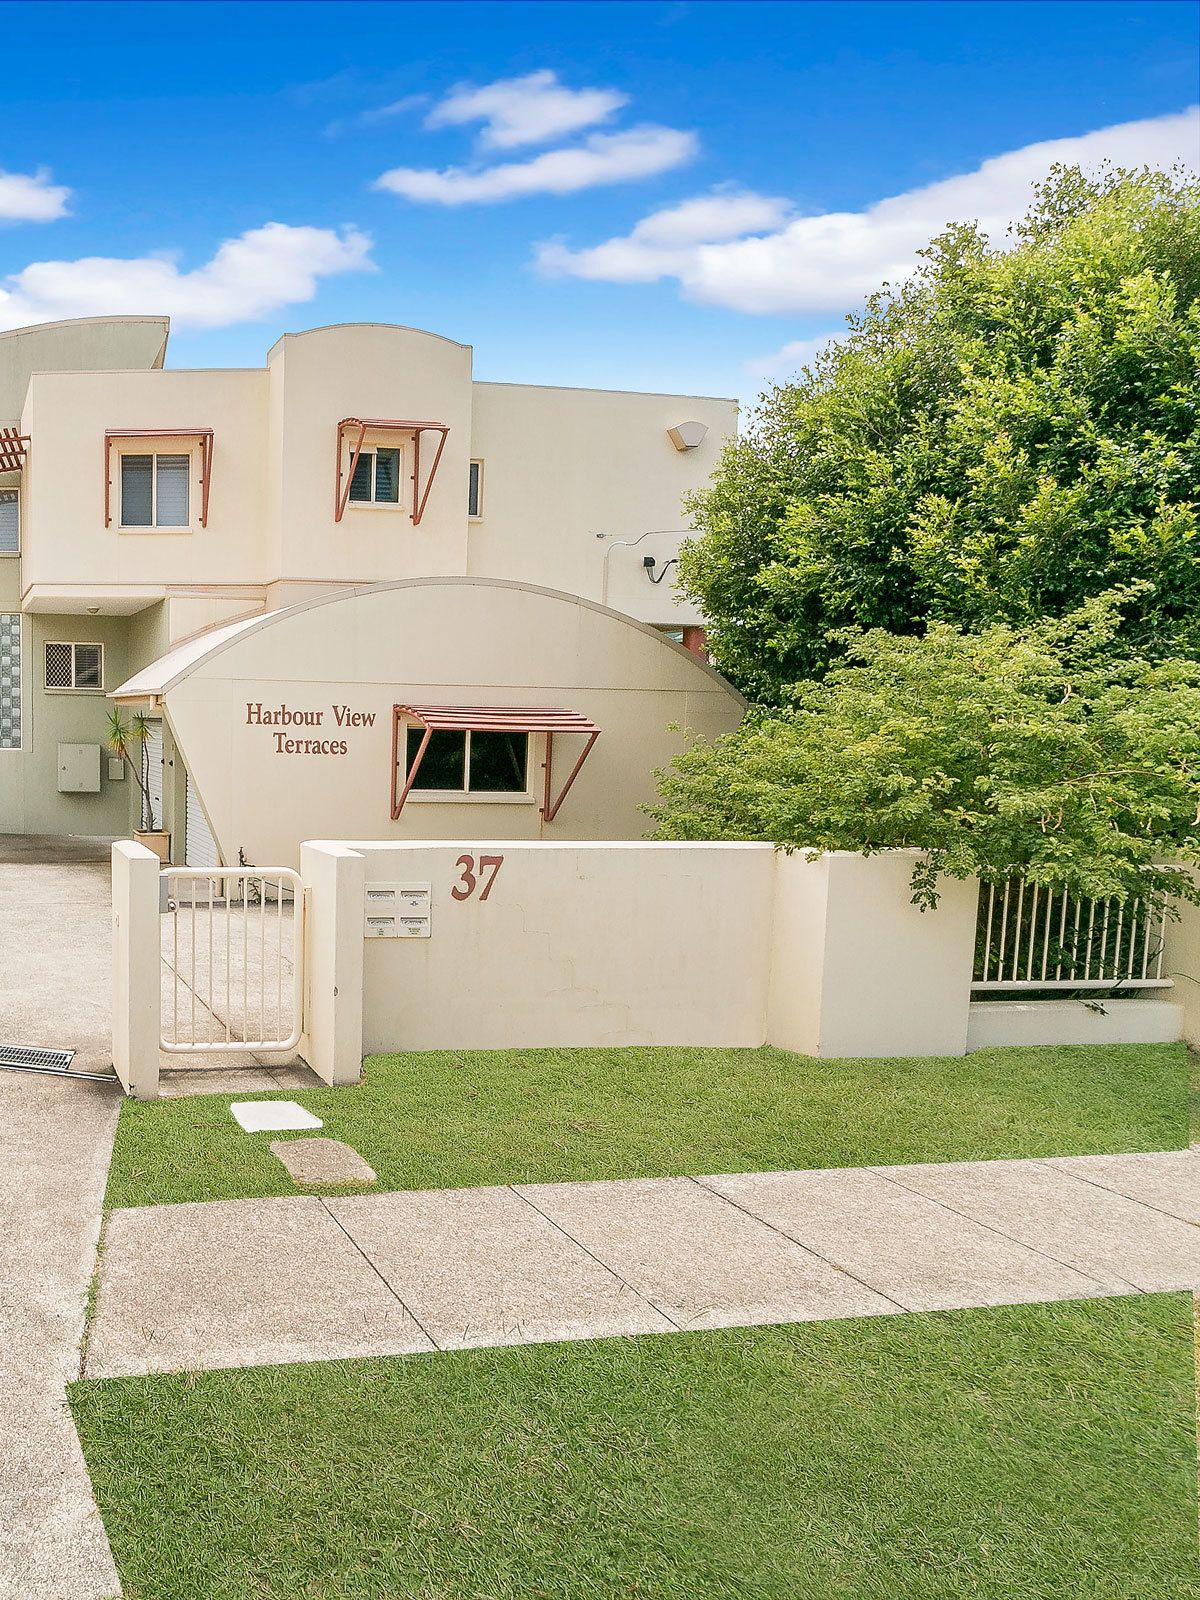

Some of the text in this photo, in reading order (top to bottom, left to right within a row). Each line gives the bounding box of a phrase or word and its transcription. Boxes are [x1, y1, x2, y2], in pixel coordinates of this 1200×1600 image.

[246, 703, 376, 727] Harbour View
[274, 732, 348, 754] Terraces
[451, 854, 504, 901] 37
